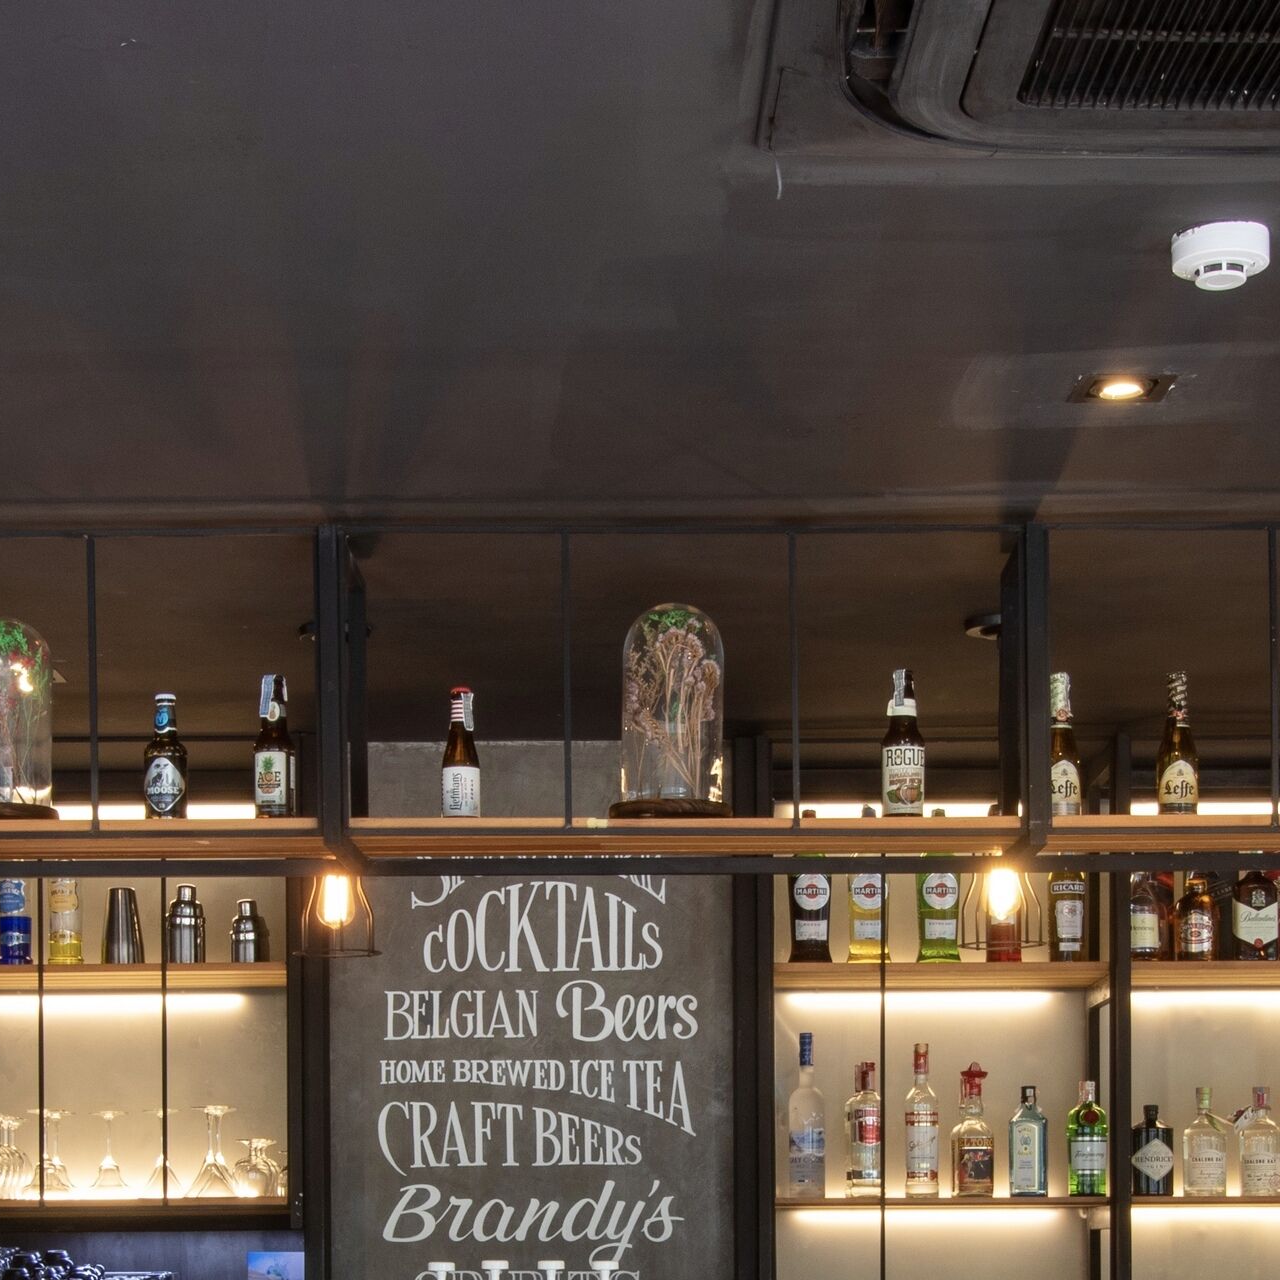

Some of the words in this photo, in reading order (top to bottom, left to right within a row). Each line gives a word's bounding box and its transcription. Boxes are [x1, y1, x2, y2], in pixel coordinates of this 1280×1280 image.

[885, 748, 925, 767] ROGUE
[257, 771, 281, 783] ACE
[146, 786, 180, 795] MOOSE
[1164, 779, 1194, 799] Leffe
[796, 887, 827, 896] MARTINI
[926, 887, 956, 895] MARTINI
[1053, 883, 1084, 891] RICARD
[423, 881, 663, 973] COCKTAILS
[384, 990, 539, 1040] BELGIAN
[556, 980, 698, 1042] Beers
[380, 1060, 445, 1085] HOME
[453, 1060, 565, 1092] BREWED
[570, 1060, 616, 1103] ICE
[623, 1060, 696, 1137] TEA
[378, 1101, 523, 1176] CRAFT
[532, 1107, 642, 1167] BEERS
[382, 1179, 685, 1268] Brandy's
